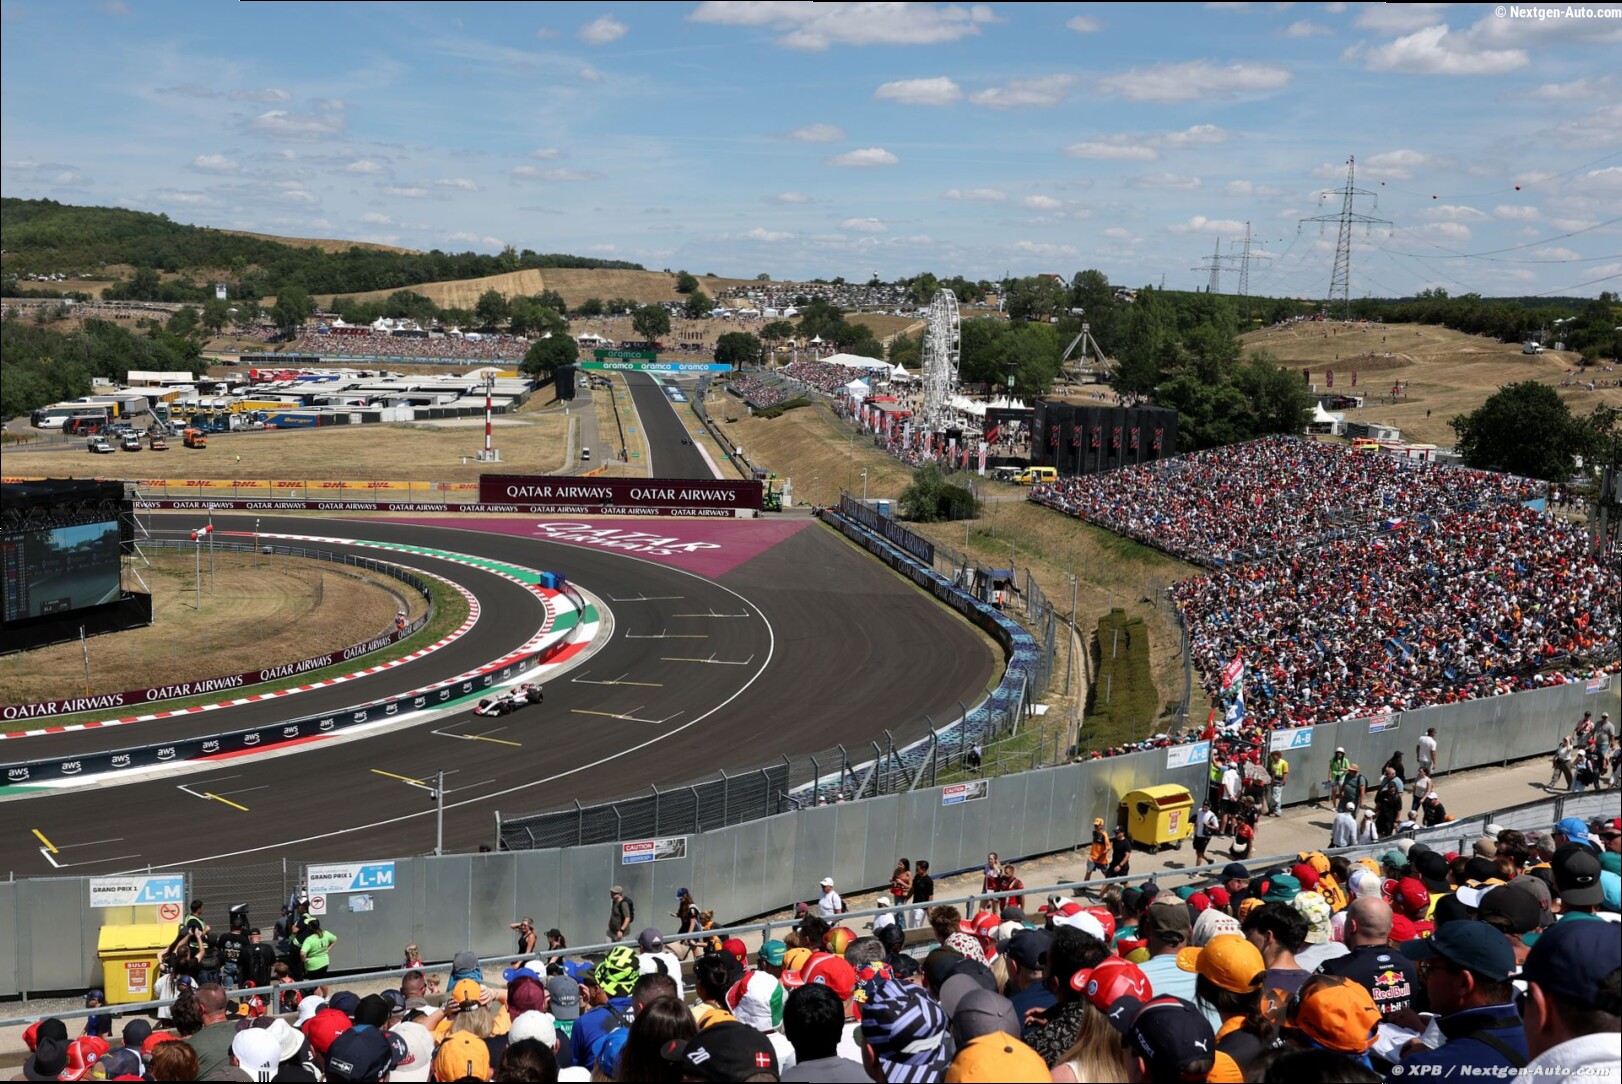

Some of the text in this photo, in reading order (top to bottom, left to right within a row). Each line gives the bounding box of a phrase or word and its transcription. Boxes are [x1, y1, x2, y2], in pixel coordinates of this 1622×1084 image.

[608, 350, 642, 359] aramco
[507, 486, 613, 498] QATAR AIRWAYS
[630, 488, 736, 501] QATAR AIRWAYS
[530, 506, 588, 514] QATAR AIRWAYS
[600, 507, 659, 515] QATAR AIRWAYS
[671, 509, 729, 517] QATAR AIRWAYS
[537, 522, 722, 552] QATAR
[343, 635, 391, 659] QATAR AIRWAYS
[260, 655, 332, 680] QATAR AIRWAYS
[147, 675, 243, 700] QATAR AIRWAYS
[3, 694, 124, 719] QATAR AIRWAYS
[625, 843, 652, 851] CAUTION
[359, 870, 393, 886] L-M
[145, 885, 181, 900] L-M
[687, 1047, 711, 1065] 20
